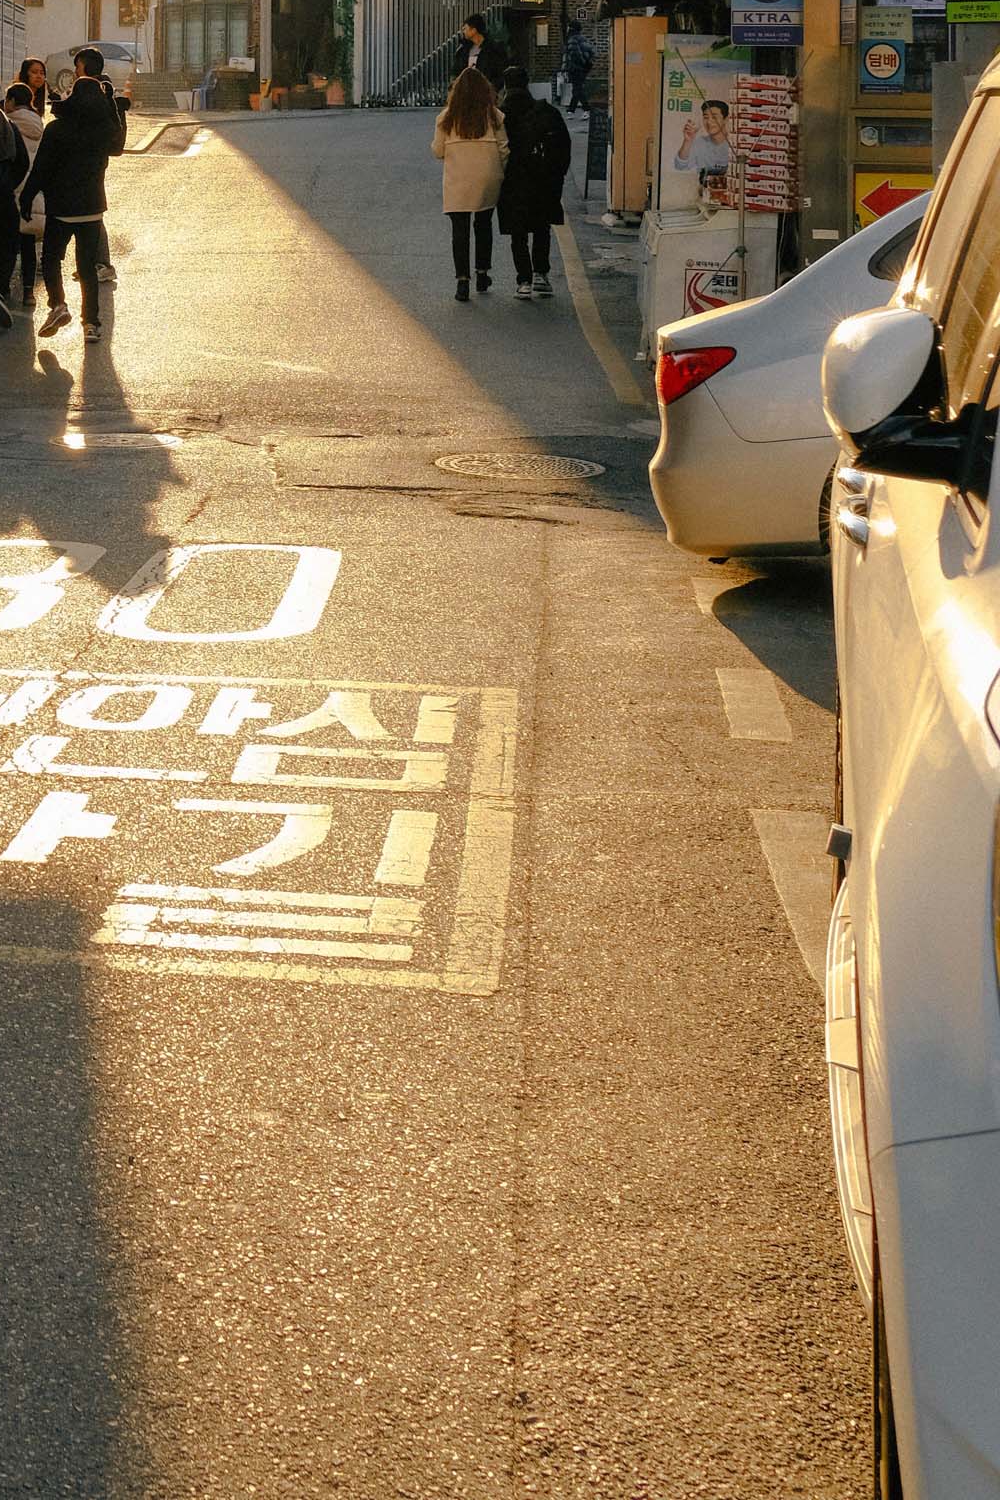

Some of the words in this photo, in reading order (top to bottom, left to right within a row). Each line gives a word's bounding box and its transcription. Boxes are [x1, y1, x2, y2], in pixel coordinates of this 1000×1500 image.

[743, 12, 792, 23] KTRA
[868, 53, 897, 68] 담배
[668, 70, 686, 88] 참
[667, 99, 693, 113] 이슬
